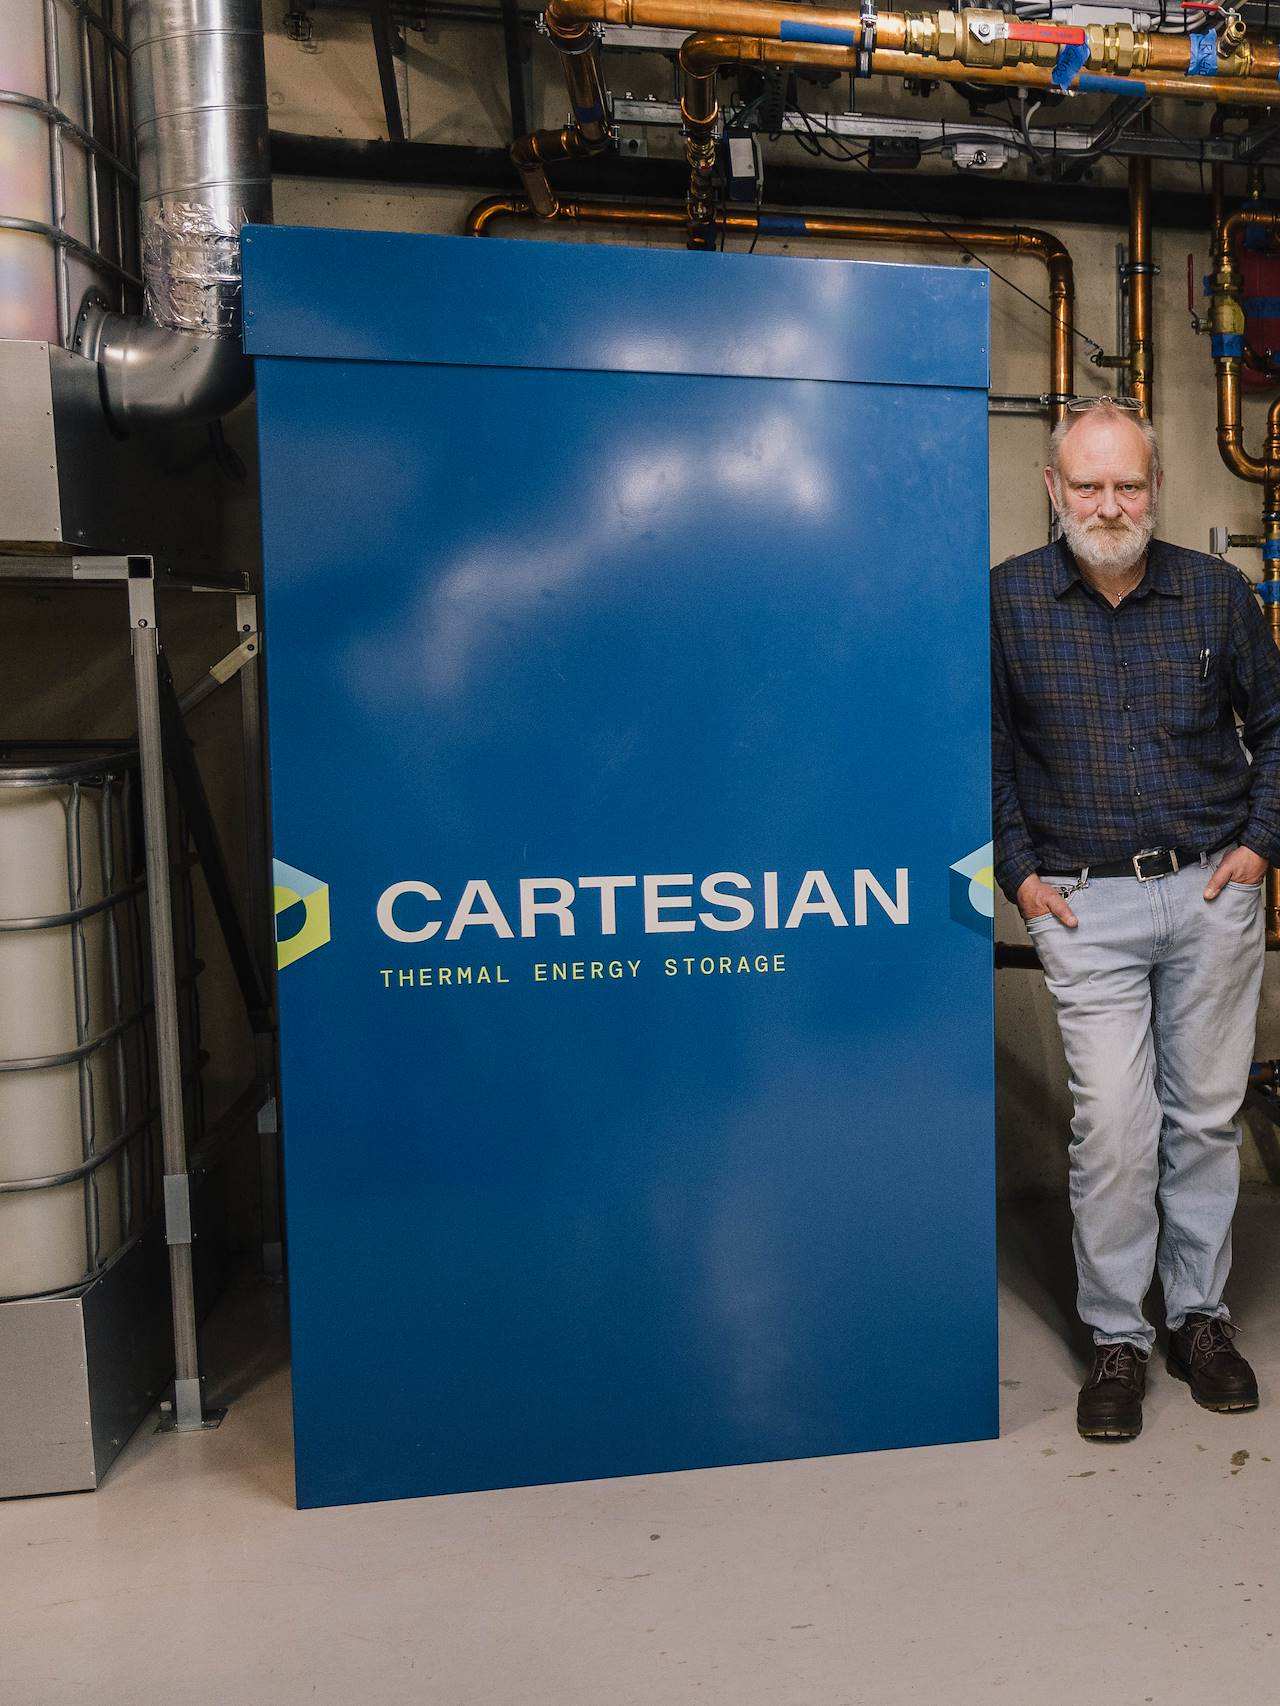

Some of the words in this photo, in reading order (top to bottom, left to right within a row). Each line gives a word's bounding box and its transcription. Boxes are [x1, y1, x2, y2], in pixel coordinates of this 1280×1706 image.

[376, 867, 909, 943] CARTESIAN
[380, 965, 510, 988] THERMAL
[534, 960, 642, 983] ENERGY
[665, 954, 787, 976] STORAGE
